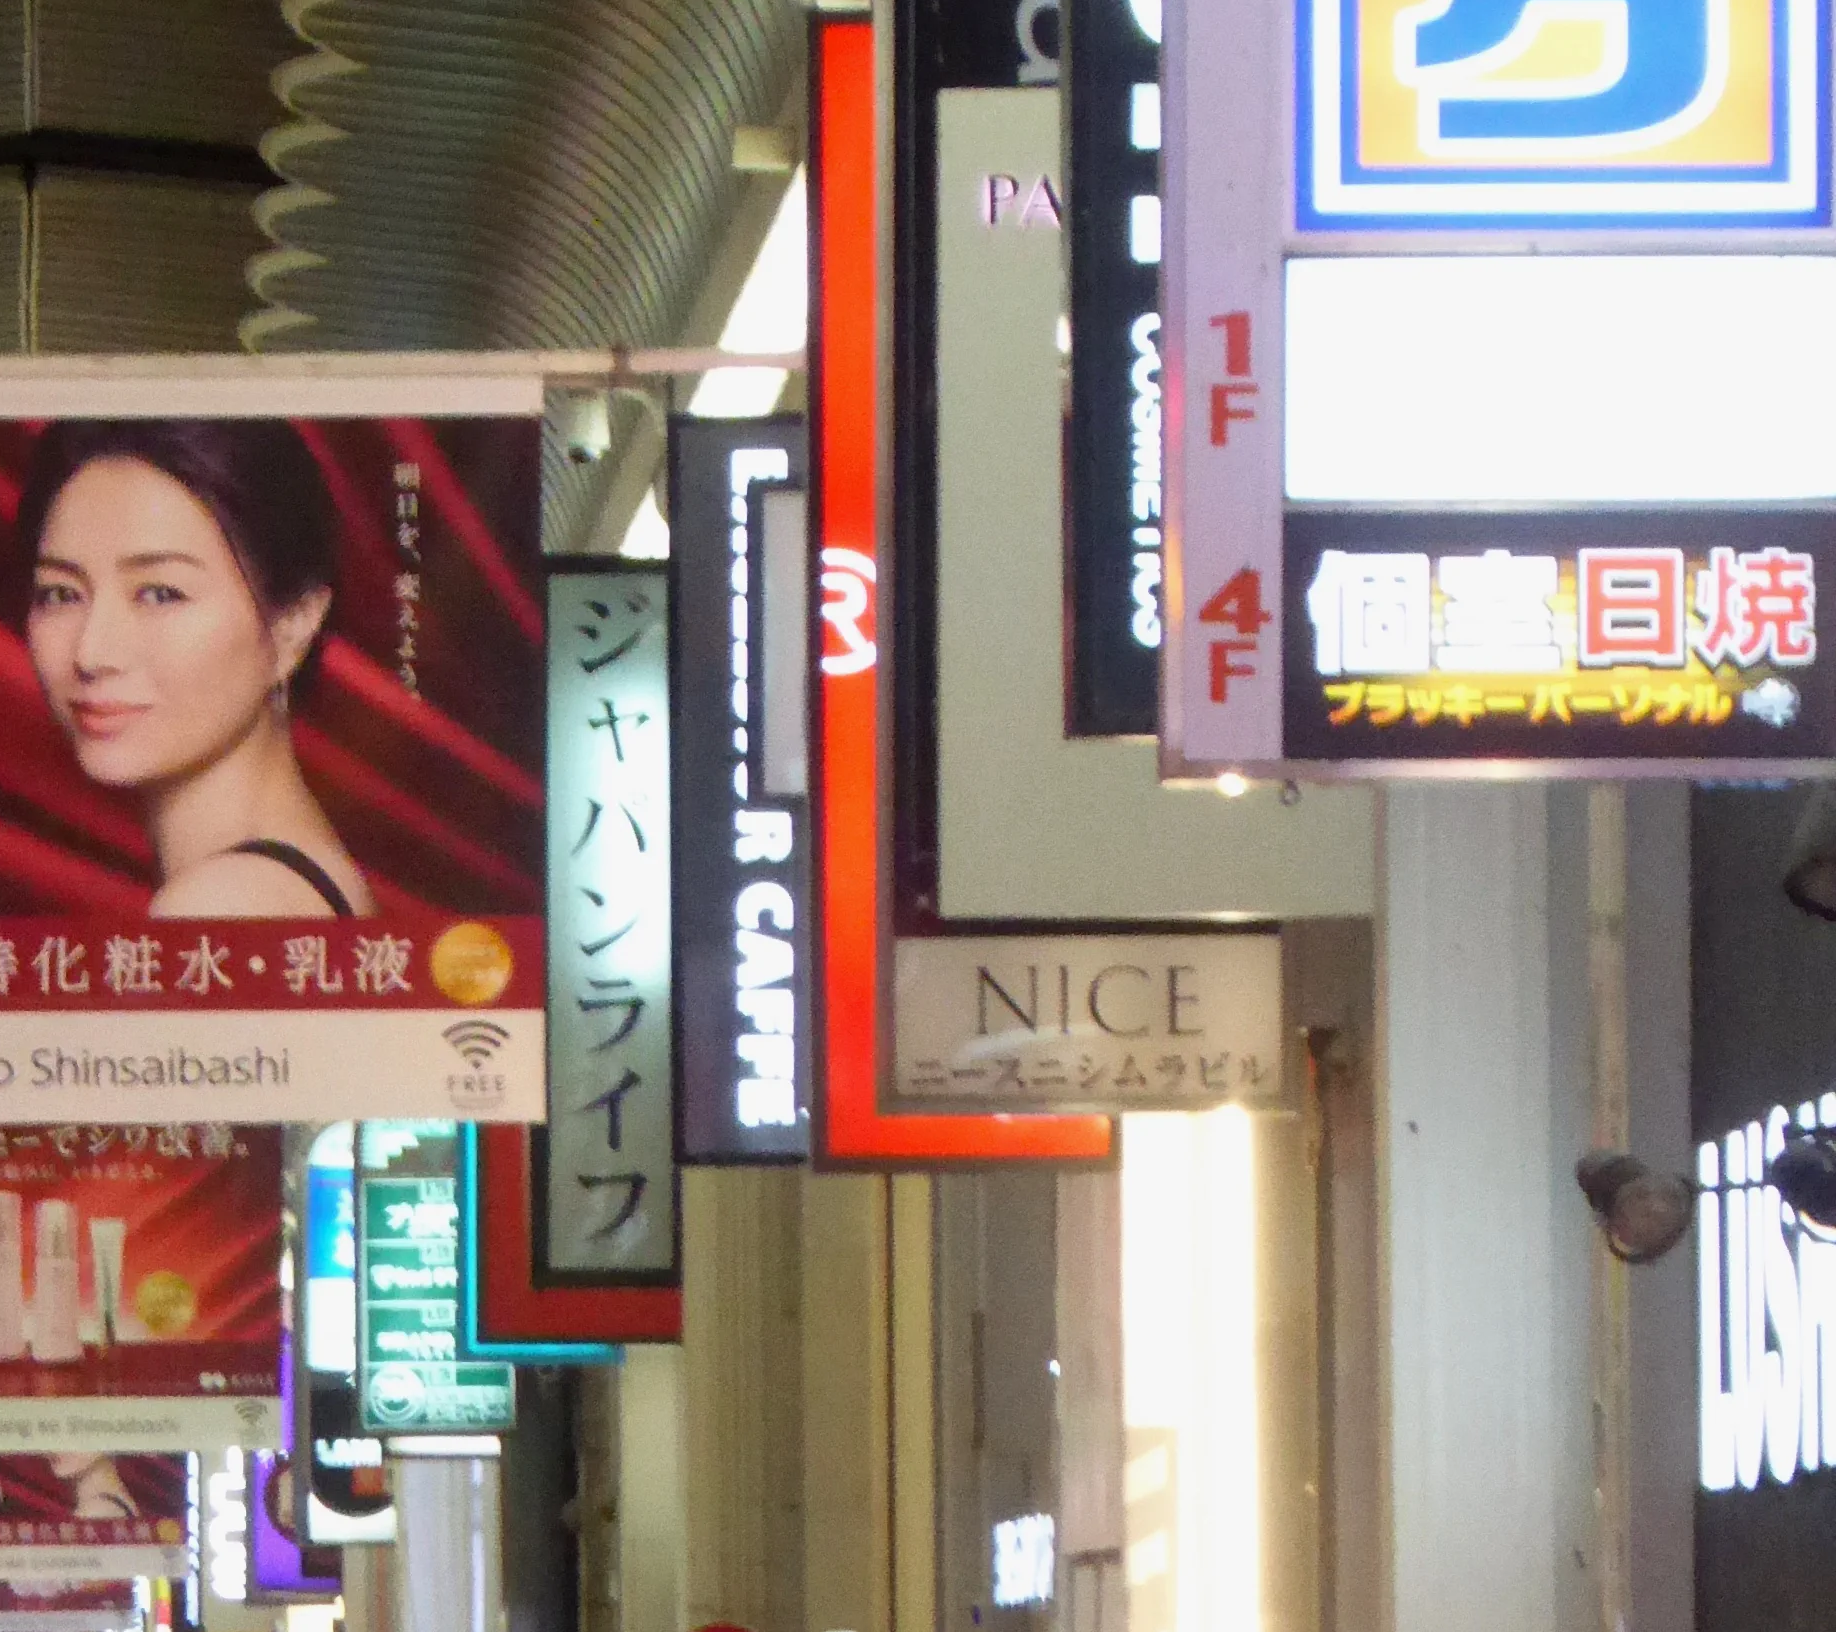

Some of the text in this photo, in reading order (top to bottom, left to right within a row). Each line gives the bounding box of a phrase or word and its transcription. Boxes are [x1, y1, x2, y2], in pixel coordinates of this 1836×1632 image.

[1208, 310, 1259, 448] 1F
[1198, 567, 1273, 704] 4F
[570, 597, 650, 1241] ジャパンライフ
[976, 963, 1203, 1036] NICE
[29, 1046, 290, 1088] Shinsaibashi
[445, 1074, 506, 1094] FREE
